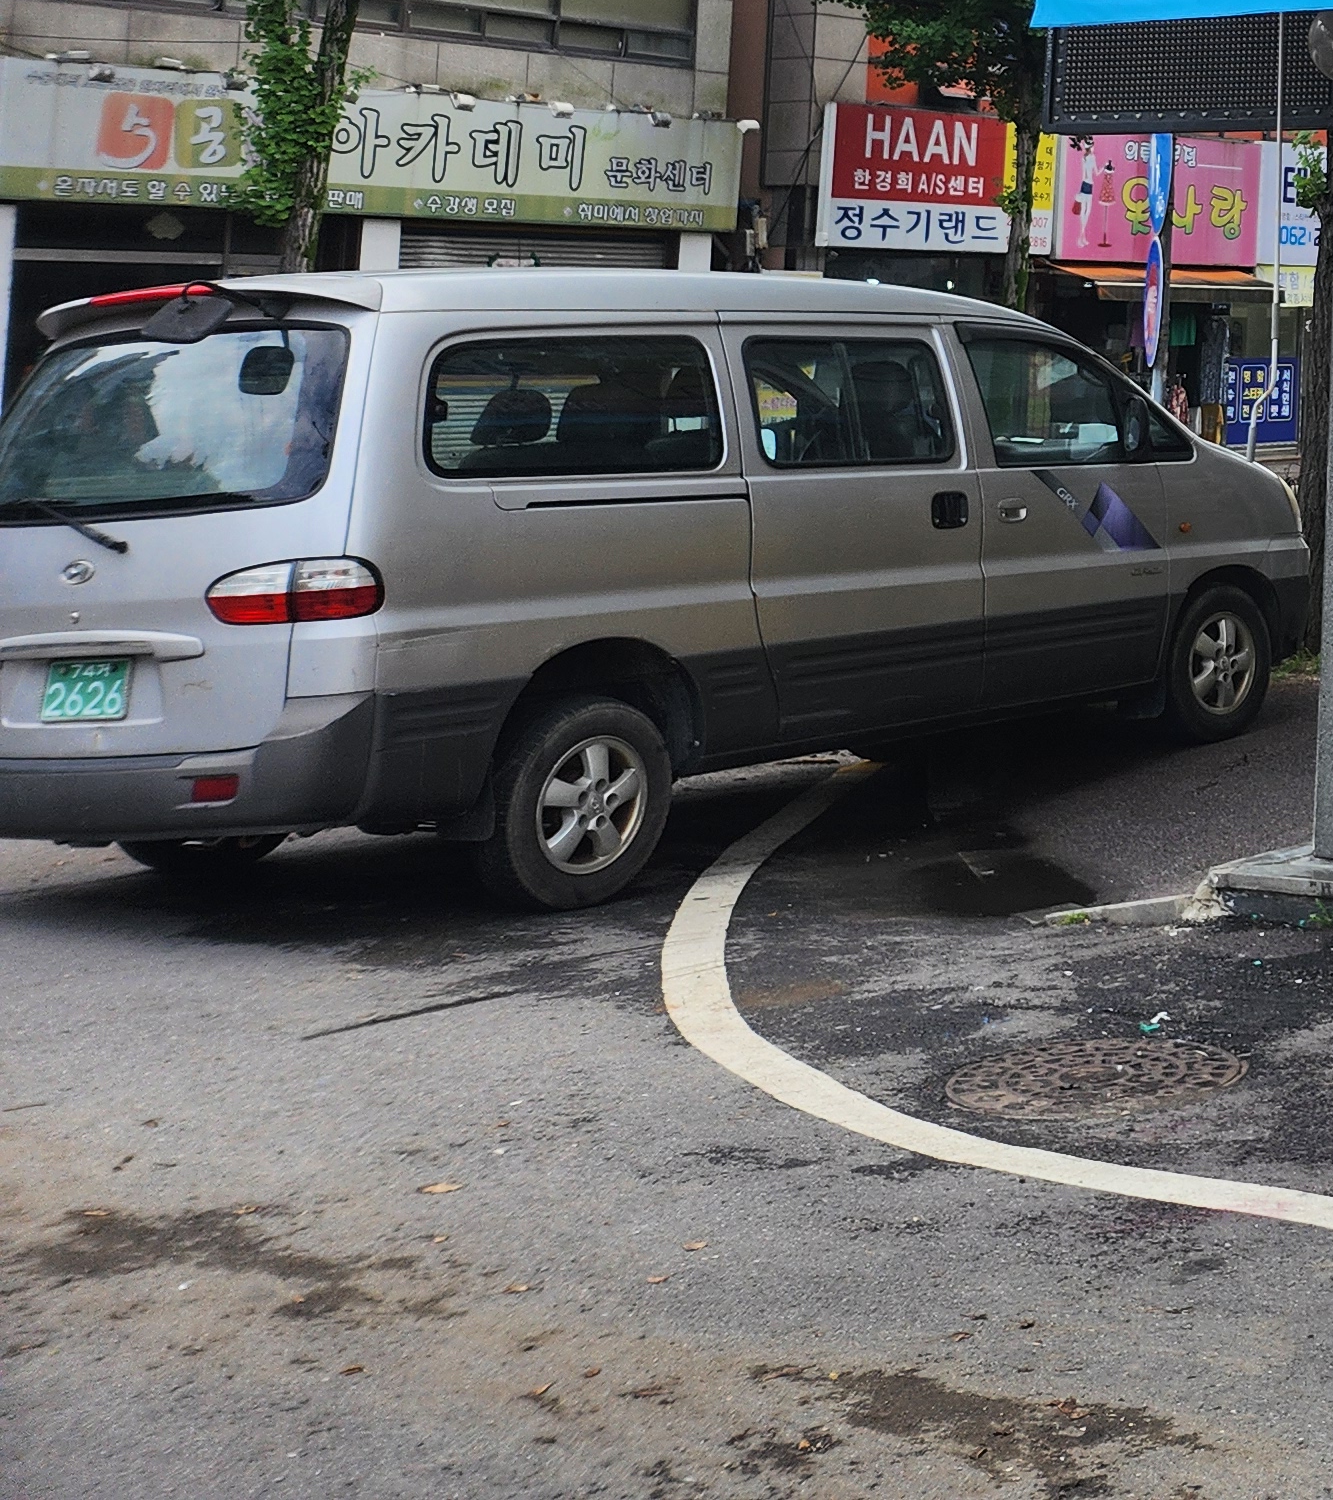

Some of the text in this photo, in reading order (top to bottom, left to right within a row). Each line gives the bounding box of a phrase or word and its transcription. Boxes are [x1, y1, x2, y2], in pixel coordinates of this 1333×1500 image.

[331, 107, 587, 192] 아카데미
[604, 156, 714, 196] 문화센터
[864, 113, 979, 167] HAAN
[172, 182, 193, 200] 수
[426, 195, 517, 217] 수강생 모집
[577, 202, 640, 222] 취미에서
[834, 205, 1000, 244] 정수기랜드
[43, 678, 124, 717] 2626
